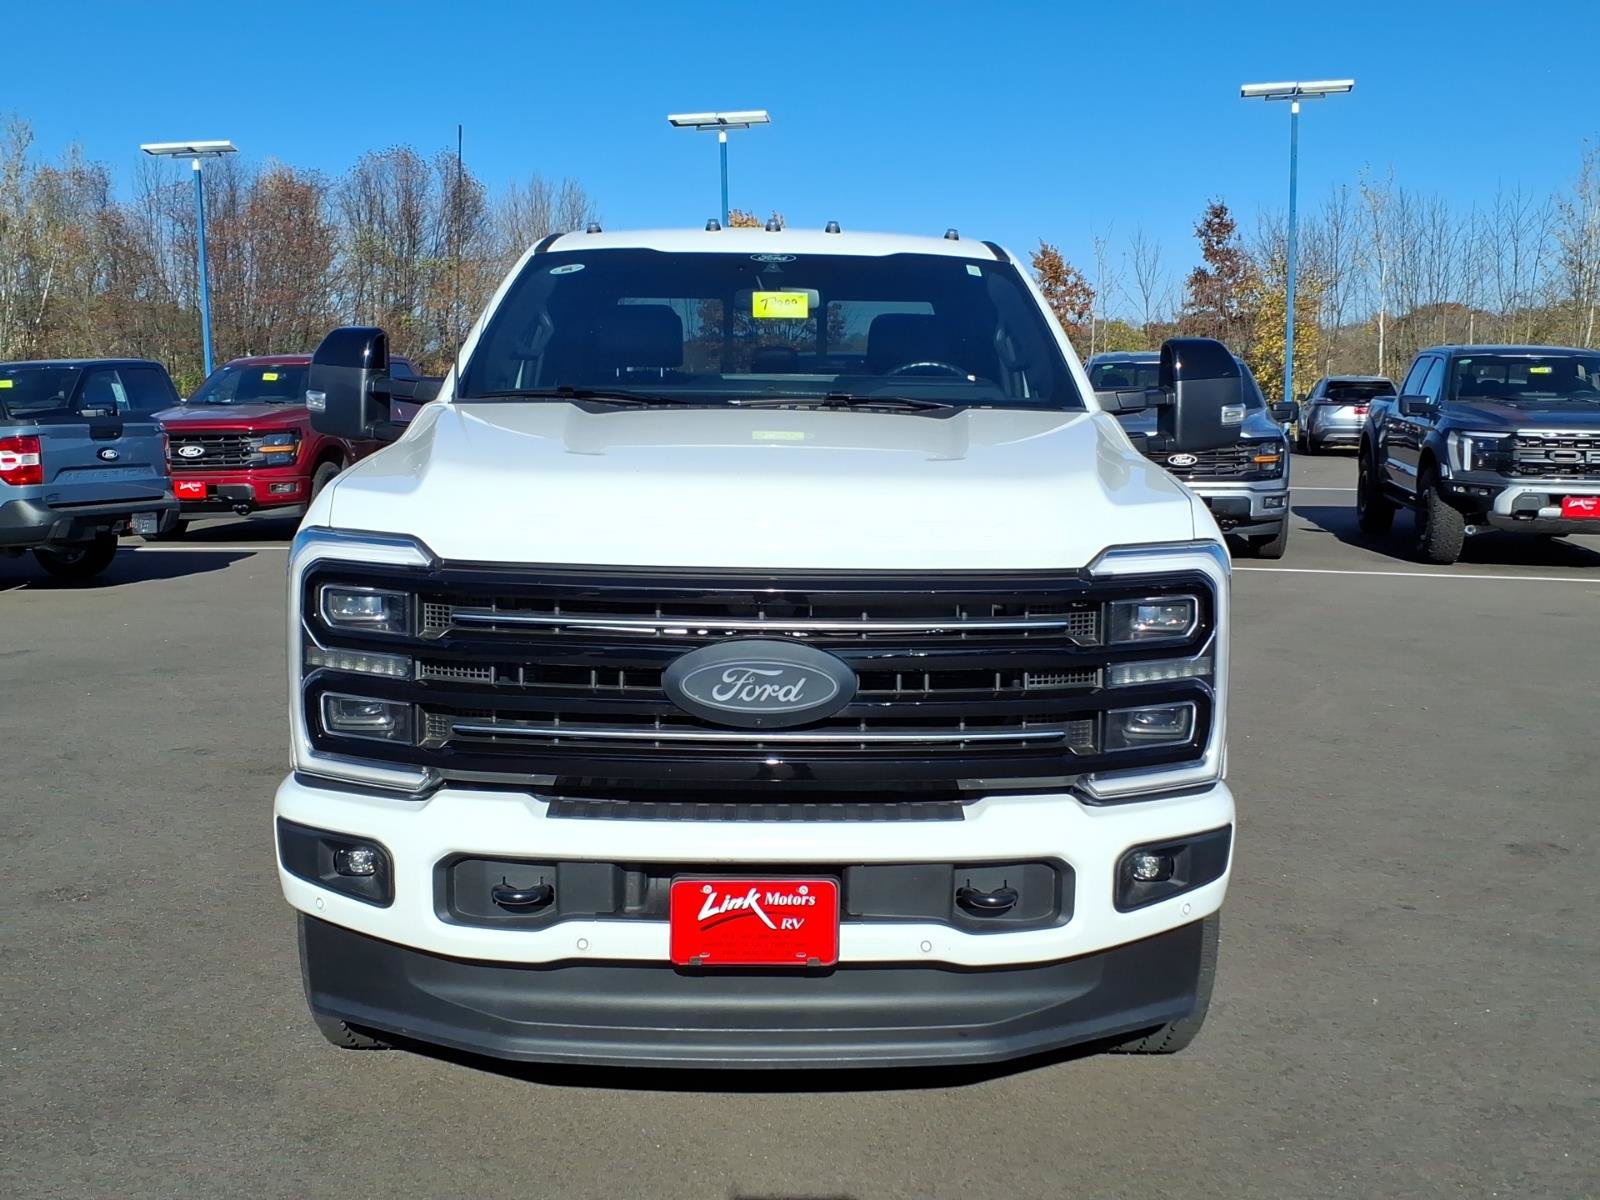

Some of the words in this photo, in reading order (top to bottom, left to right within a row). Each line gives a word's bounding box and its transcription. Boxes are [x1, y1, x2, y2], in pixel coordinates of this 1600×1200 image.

[711, 667, 807, 702] Ford
[697, 888, 777, 930] Link
[764, 891, 816, 906] Motors
[781, 917, 805, 930] RV
